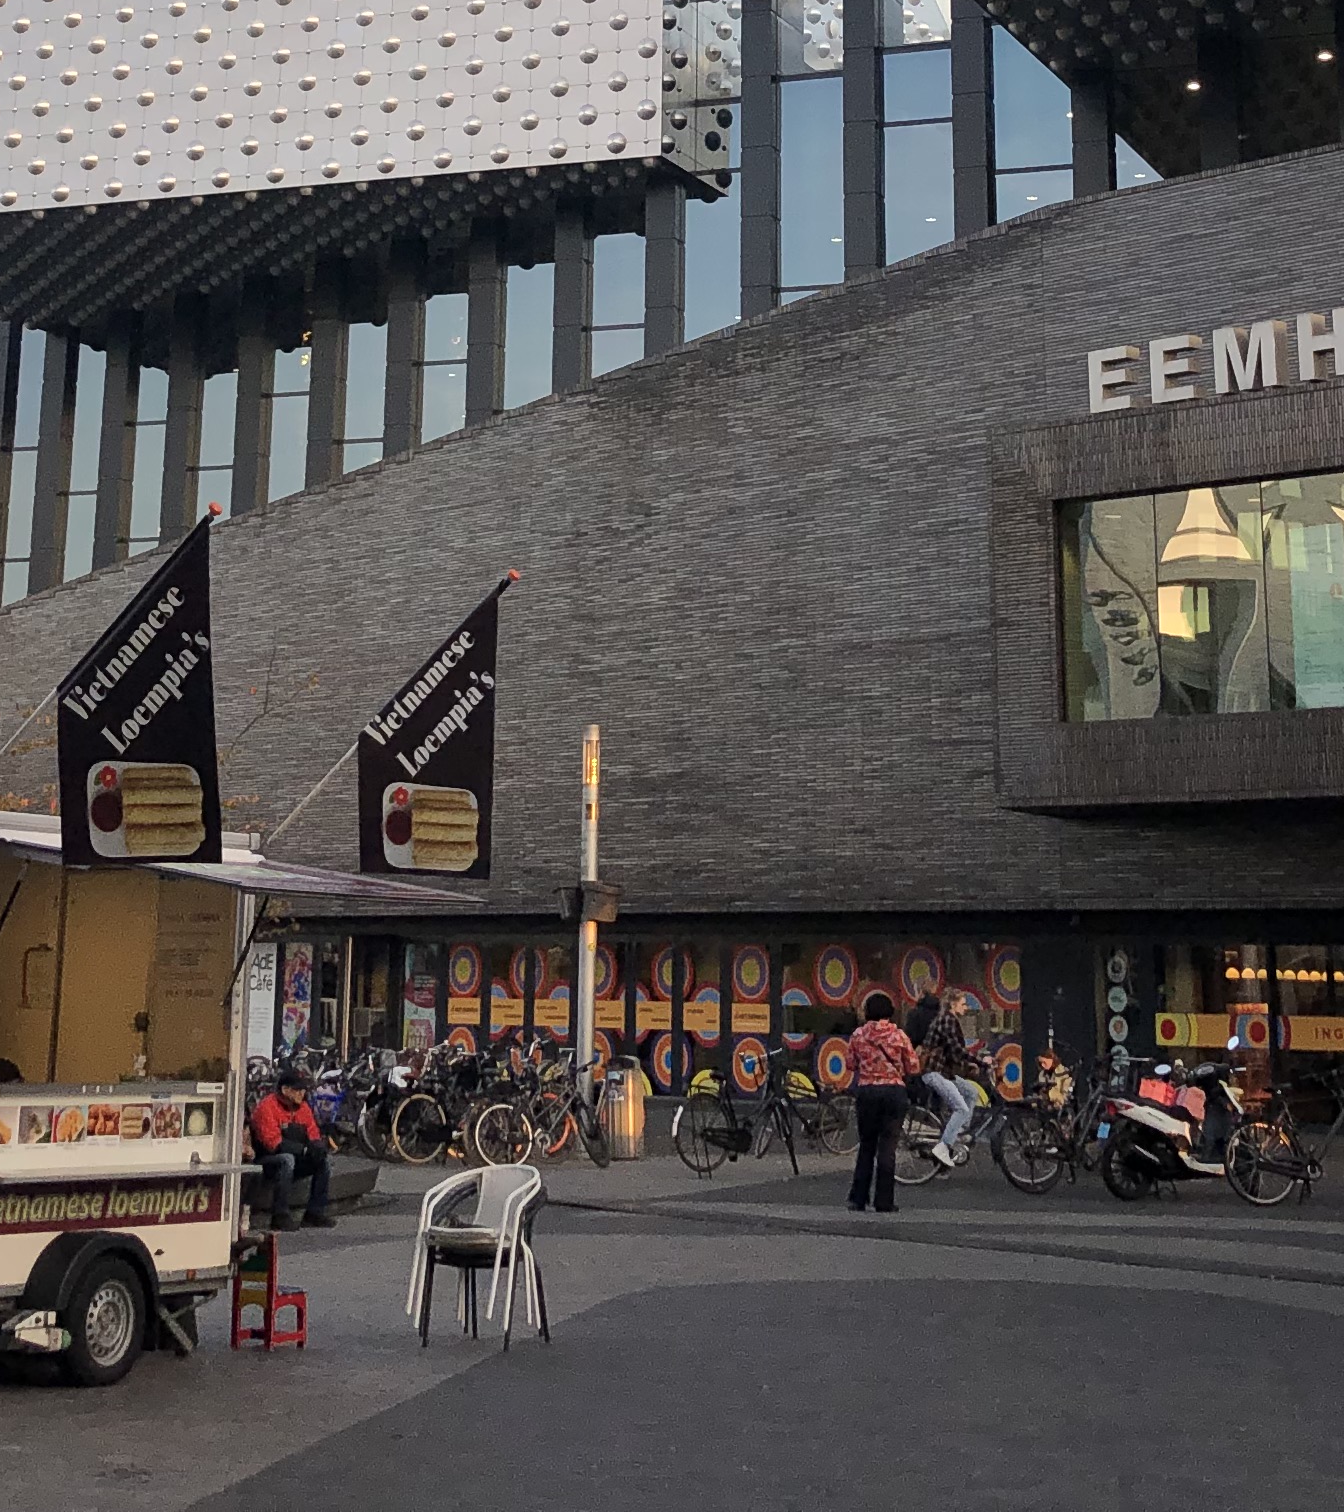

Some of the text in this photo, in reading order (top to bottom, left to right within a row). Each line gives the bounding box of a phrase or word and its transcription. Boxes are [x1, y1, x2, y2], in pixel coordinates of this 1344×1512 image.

[62, 583, 186, 722] Vietnamese
[98, 628, 211, 756] Loempia's
[362, 628, 476, 748] Vietnamese
[394, 668, 496, 779] Loempia's
[105, 1182, 210, 1224] loempia's
